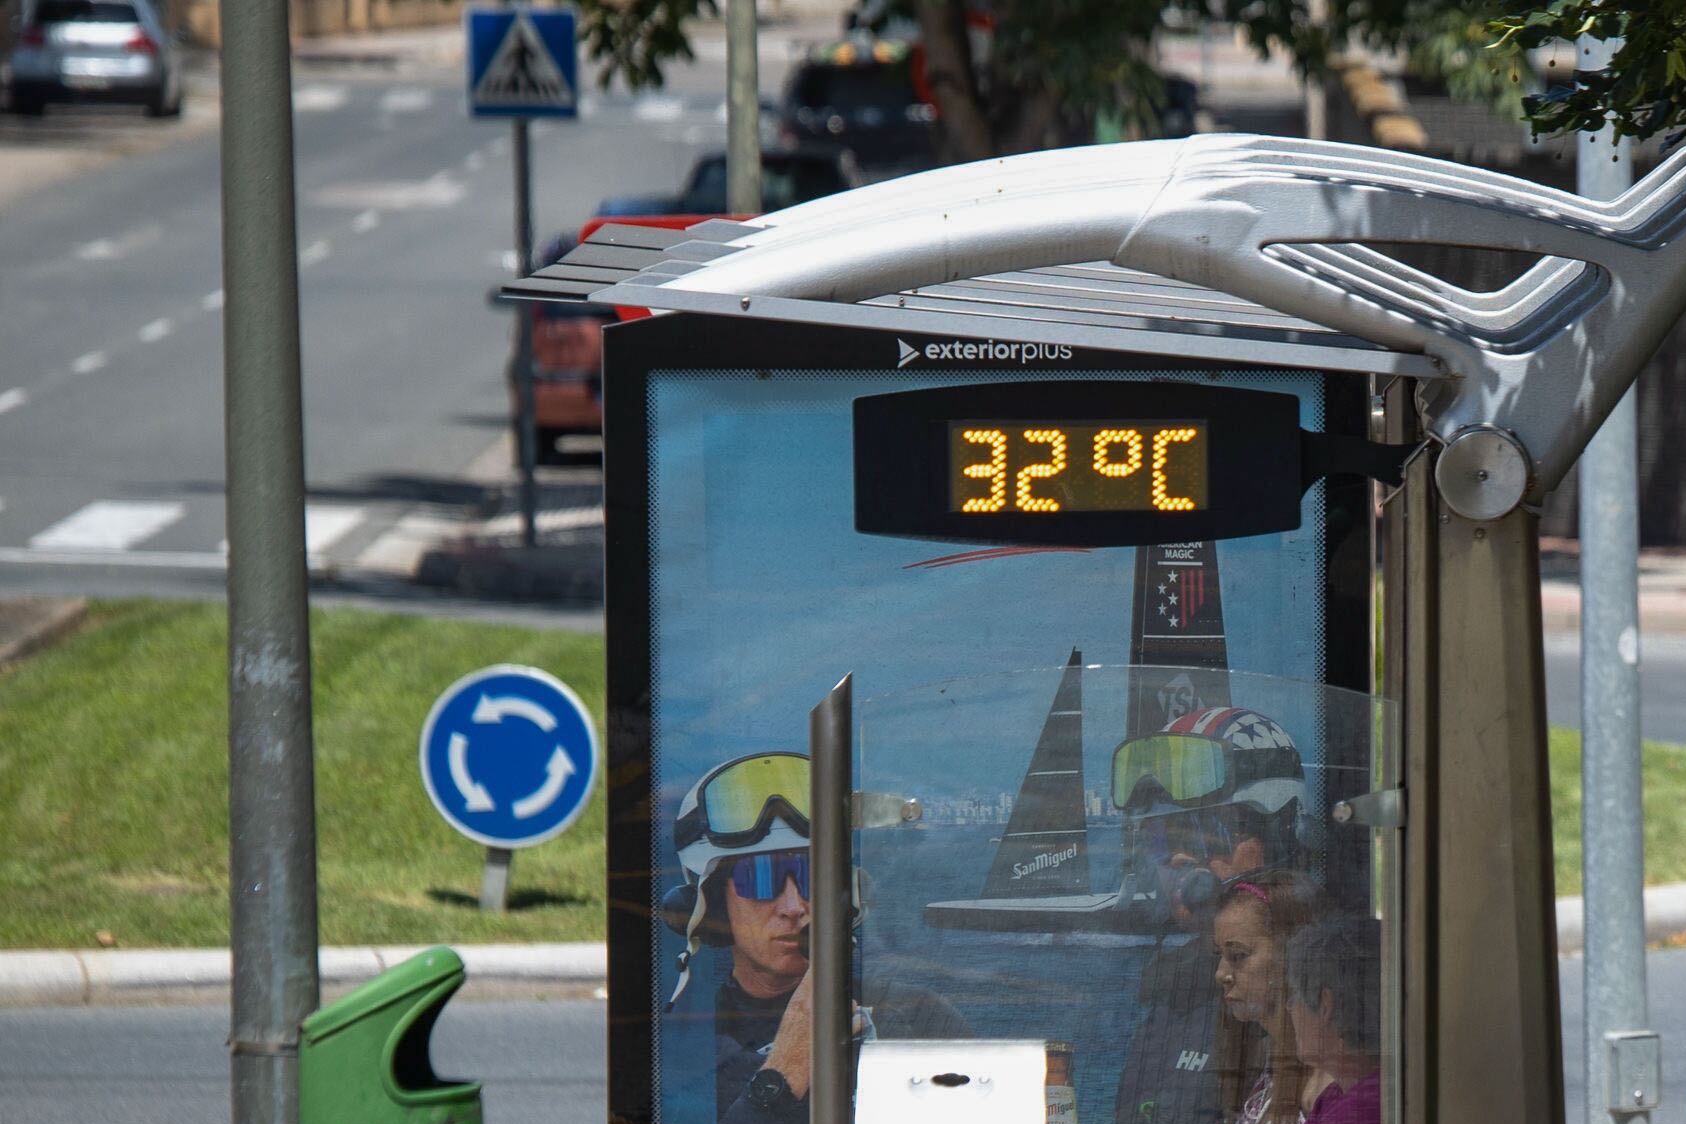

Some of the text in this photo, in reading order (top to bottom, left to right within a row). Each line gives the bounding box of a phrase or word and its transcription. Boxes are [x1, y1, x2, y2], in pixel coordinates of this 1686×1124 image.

[924, 339, 1072, 363] exteriorplus
[962, 429, 1067, 512] 32
[1164, 549, 1195, 559] MAGIC
